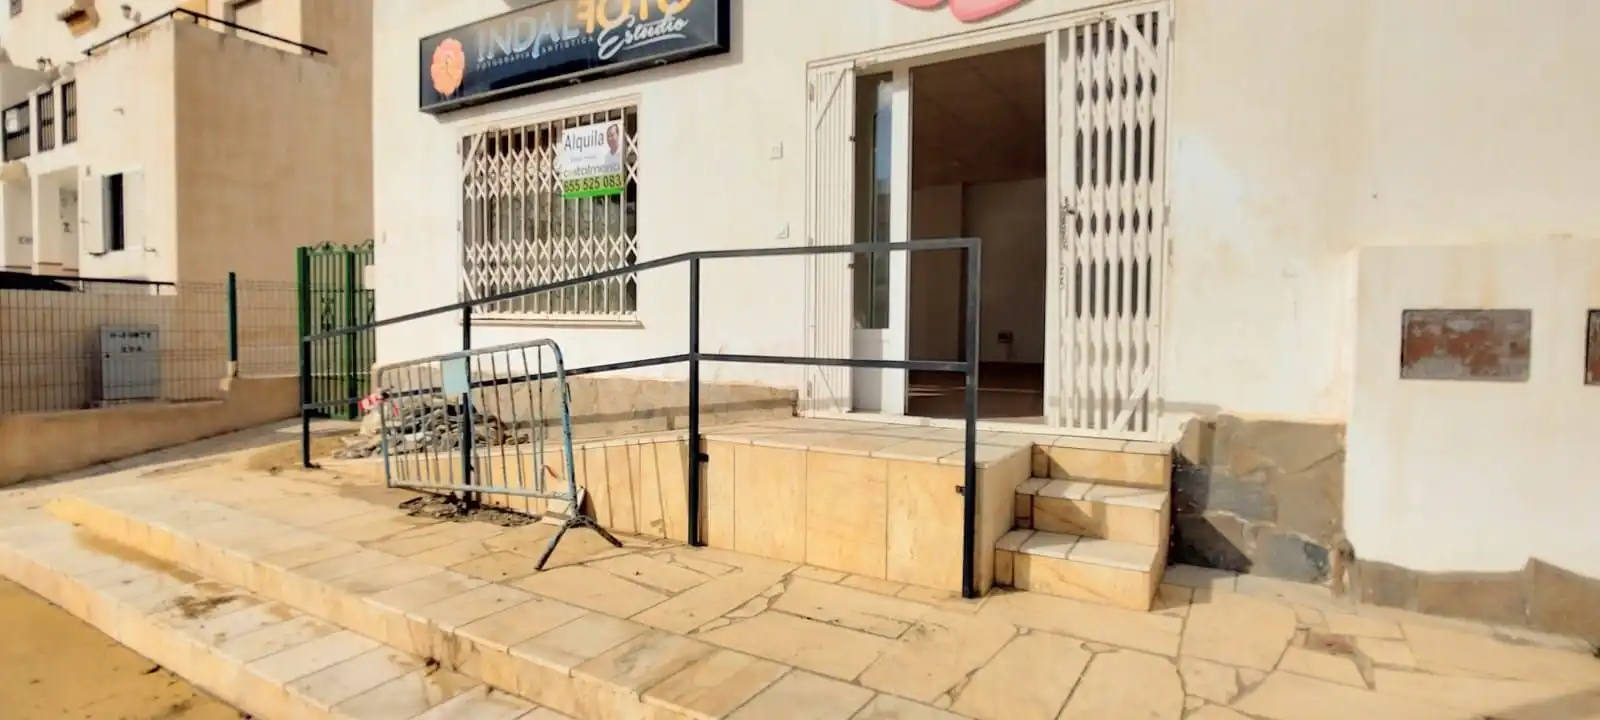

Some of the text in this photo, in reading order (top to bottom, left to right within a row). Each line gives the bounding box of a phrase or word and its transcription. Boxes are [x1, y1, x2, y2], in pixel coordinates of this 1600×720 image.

[597, 5, 690, 60] Estudio
[564, 130, 605, 152] Alquila
[582, 177, 601, 191] 525
[603, 174, 621, 188] 083
